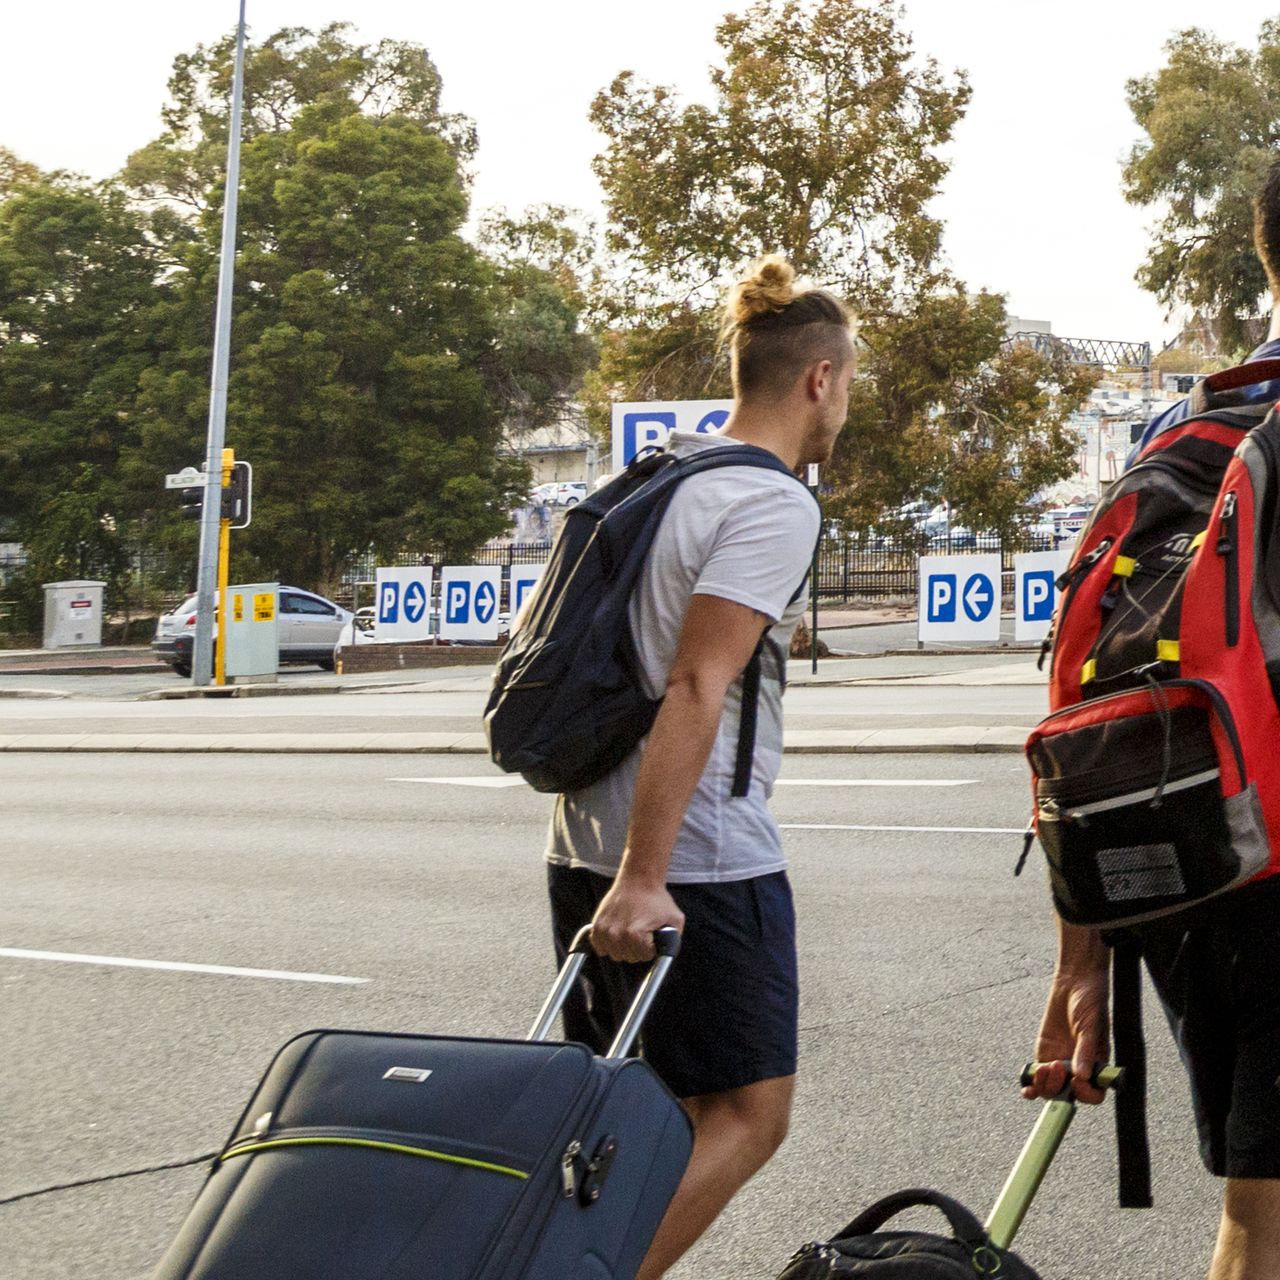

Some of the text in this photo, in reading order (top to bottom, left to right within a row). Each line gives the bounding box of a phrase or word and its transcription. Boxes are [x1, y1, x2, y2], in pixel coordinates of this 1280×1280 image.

[382, 587, 395, 618] P
[451, 587, 466, 618] P
[933, 581, 951, 616] P
[1028, 579, 1049, 615] P
